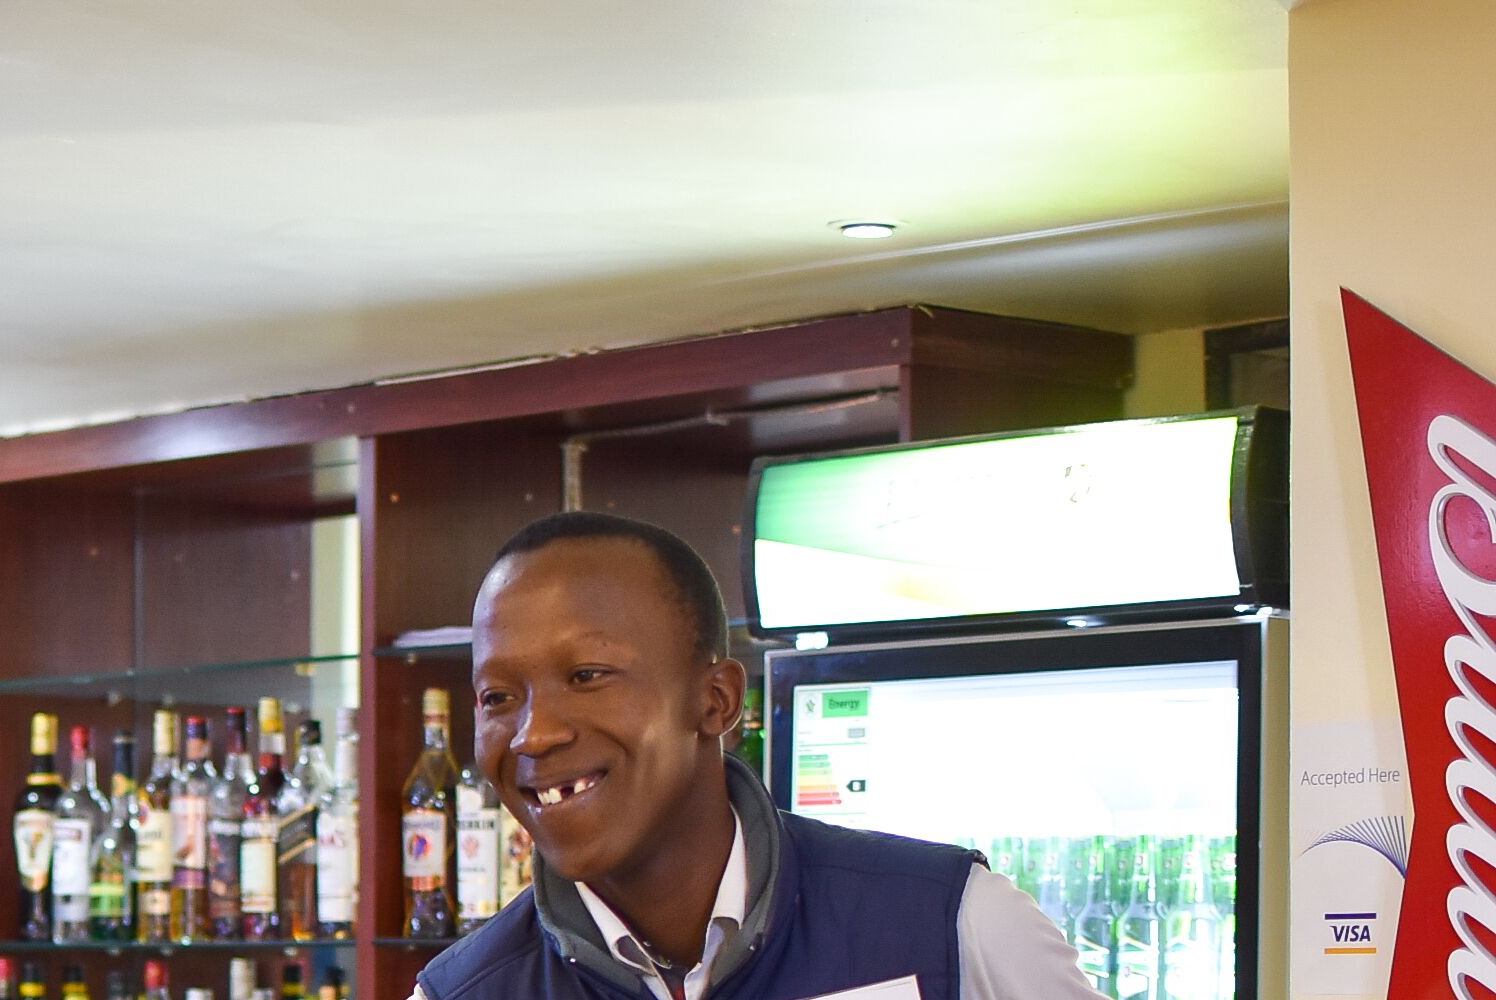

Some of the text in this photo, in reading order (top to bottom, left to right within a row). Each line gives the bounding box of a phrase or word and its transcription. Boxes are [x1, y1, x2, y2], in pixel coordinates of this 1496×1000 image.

[828, 699, 860, 711] Energy
[1301, 767, 1401, 788] Accepted Here
[1329, 924, 1371, 942] VISA
